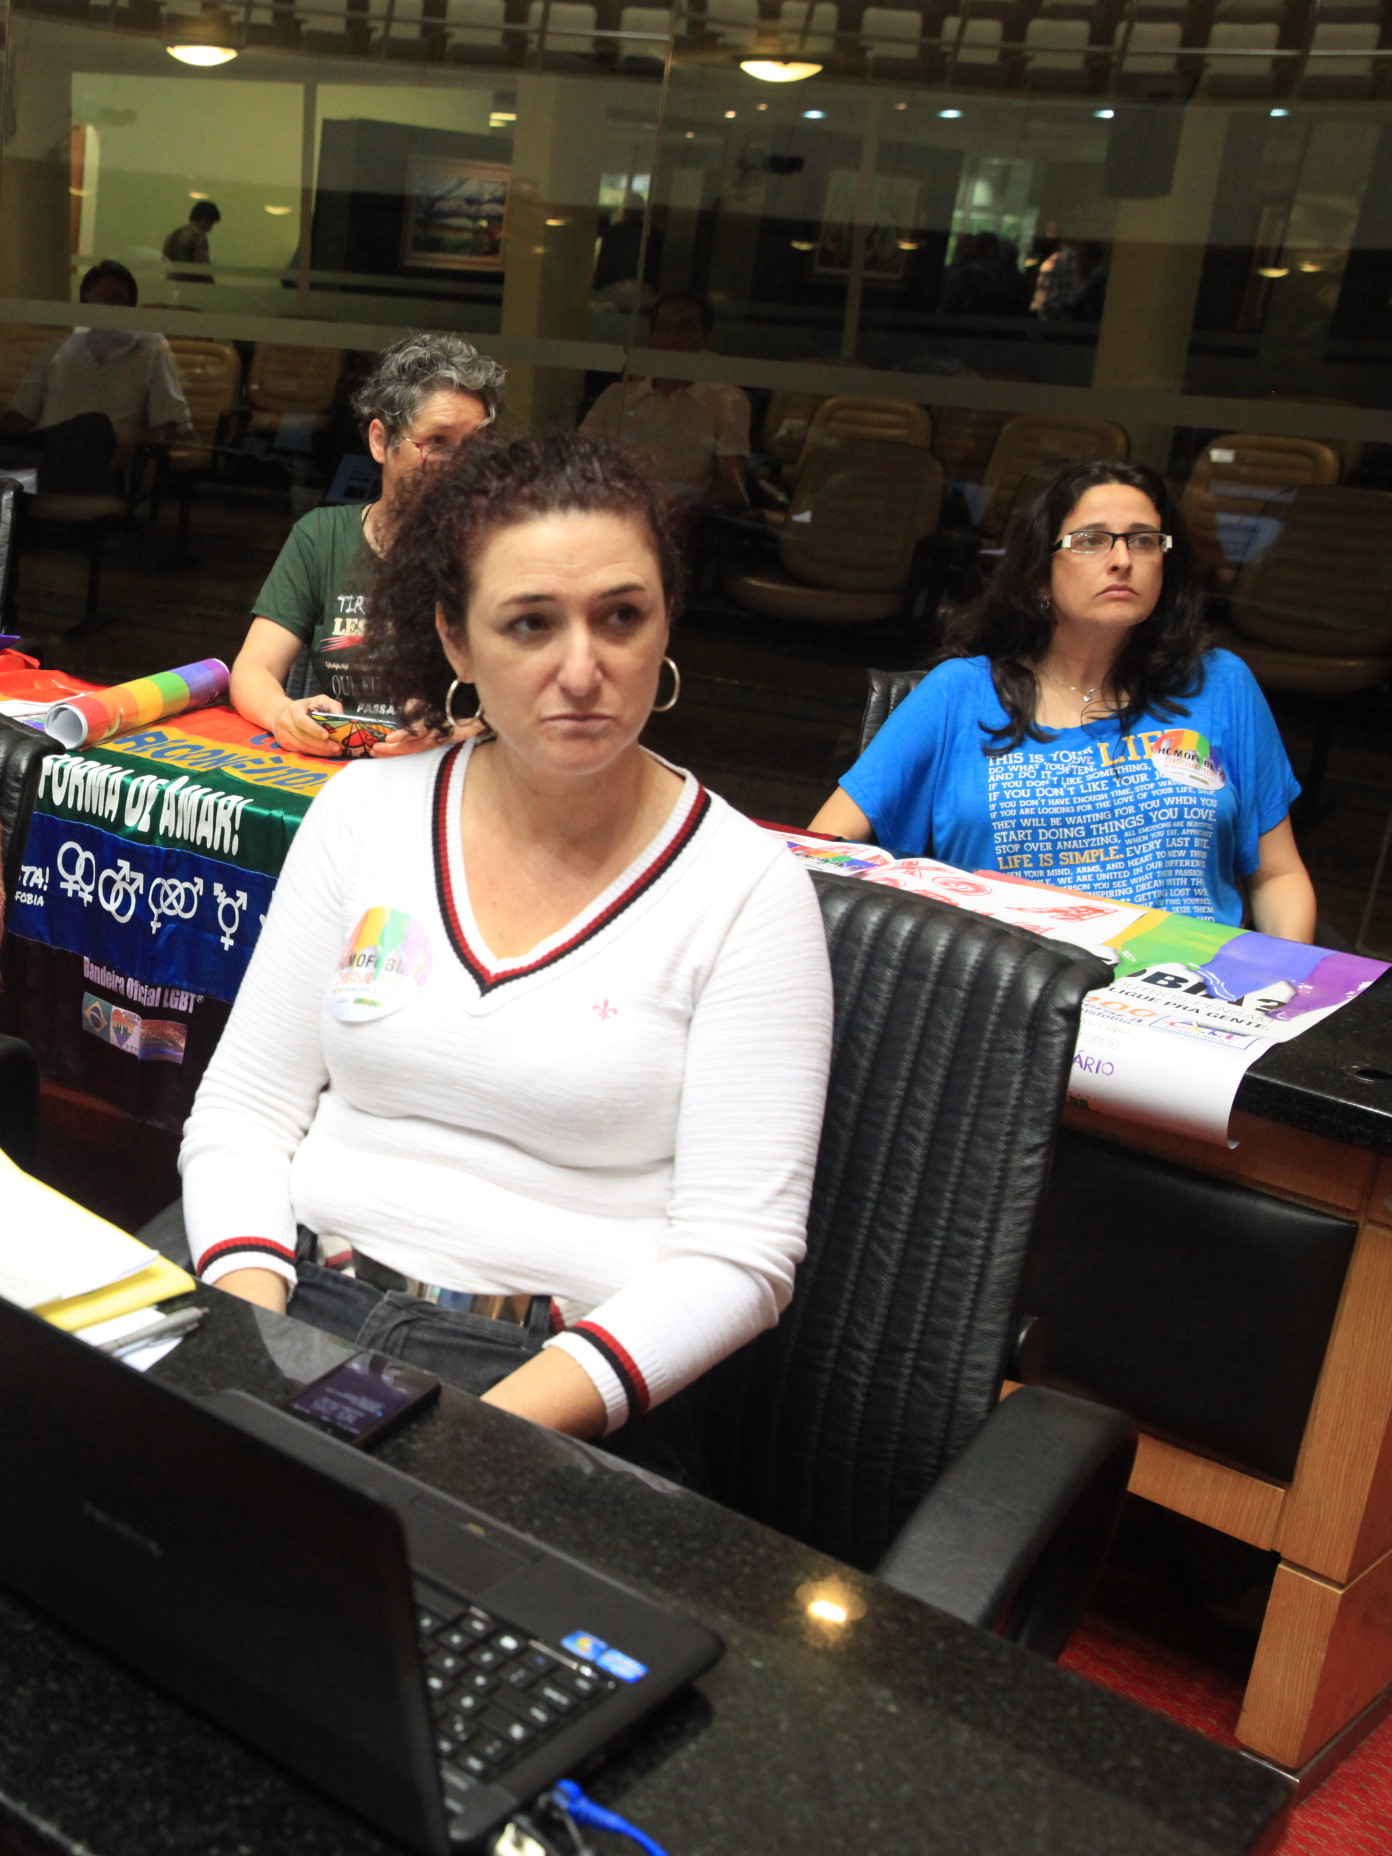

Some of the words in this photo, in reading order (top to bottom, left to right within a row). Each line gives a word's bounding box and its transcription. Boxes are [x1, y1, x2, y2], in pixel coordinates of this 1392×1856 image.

[987, 752, 1024, 766] THIS
[1029, 754, 1045, 763] IS
[1097, 730, 1166, 767] LIF
[988, 773, 1014, 782] AND
[1002, 781, 1022, 789] YOU
[1061, 777, 1083, 785] LIKE
[1086, 763, 1151, 781] SOMETHING,
[1044, 762, 1064, 770] YOU
[988, 792, 1000, 801] IF
[1003, 789, 1031, 799] YOU
[1036, 785, 1074, 797] DON'T
[1080, 780, 1109, 793] LIKE
[1113, 773, 1149, 787] YOUR
[1020, 797, 1045, 806] DON'T
[1049, 797, 1070, 805] HAVE
[1073, 793, 1108, 804] ENOUGH
[1110, 788, 1134, 797] TIME,
[1134, 783, 1155, 792] STOP
[38, 754, 134, 822] FORMA
[159, 775, 254, 856] AMAR!
[992, 820, 1016, 830] THEY
[1020, 818, 1046, 827] WILL
[1050, 818, 1062, 826] BE
[1065, 811, 1111, 825] WAITING
[1114, 806, 1135, 817] FOR
[1138, 799, 1160, 811] YOU
[1164, 797, 1197, 806] WHEN
[1200, 798, 1217, 807] YOU
[1000, 809, 1016, 817] YOU
[1095, 801, 1111, 809] THE
[1114, 795, 1135, 805] LOVE
[1151, 788, 1174, 796] YOUR
[993, 830, 1032, 843] START
[1038, 827, 1085, 840] DOING
[1090, 814, 1145, 835] THINGS
[1149, 808, 1178, 822] YOU
[995, 844, 1020, 854] STOP
[1024, 842, 1052, 852] OVER
[1056, 834, 1121, 850] ANALYZING,
[1138, 822, 1171, 834] EMOTIONS
[997, 854, 1033, 870] LIFE
[1038, 854, 1054, 867] IS
[1059, 846, 1125, 865] SIMPLE.
[1125, 840, 1162, 857] EVERY
[1166, 837, 1190, 847] LAST
[1125, 835, 1148, 845] WHEN
[19, 864, 49, 891] TA!
[1024, 870, 1045, 878] YOUR
[1047, 868, 1073, 876] MIND,
[1076, 865, 1103, 874] ARMS,
[1106, 862, 1125, 871] AND
[1128, 854, 1153, 867] HEART
[1156, 851, 1166, 859] TO
[1168, 850, 1186, 858] NEW
[1076, 875, 1094, 883] ARE
[1096, 870, 1130, 881] UNITED
[1133, 866, 1143, 874] IN
[1145, 862, 1163, 871] OUR
[1093, 882, 1110, 890] YOU
[1112, 880, 1128, 888] SEE
[1129, 872, 1153, 885] WHAT
[1166, 878, 1187, 886] WITH
[1170, 888, 1190, 896] LOST
[83, 956, 125, 996] Bandeira
[126, 977, 162, 1007] Oficial
[1114, 980, 1192, 1006] OUTROS
[1108, 987, 1160, 1005] LIGUE
[1164, 1001, 1201, 1014] PRA
[1206, 1012, 1270, 1031] GENTE.
